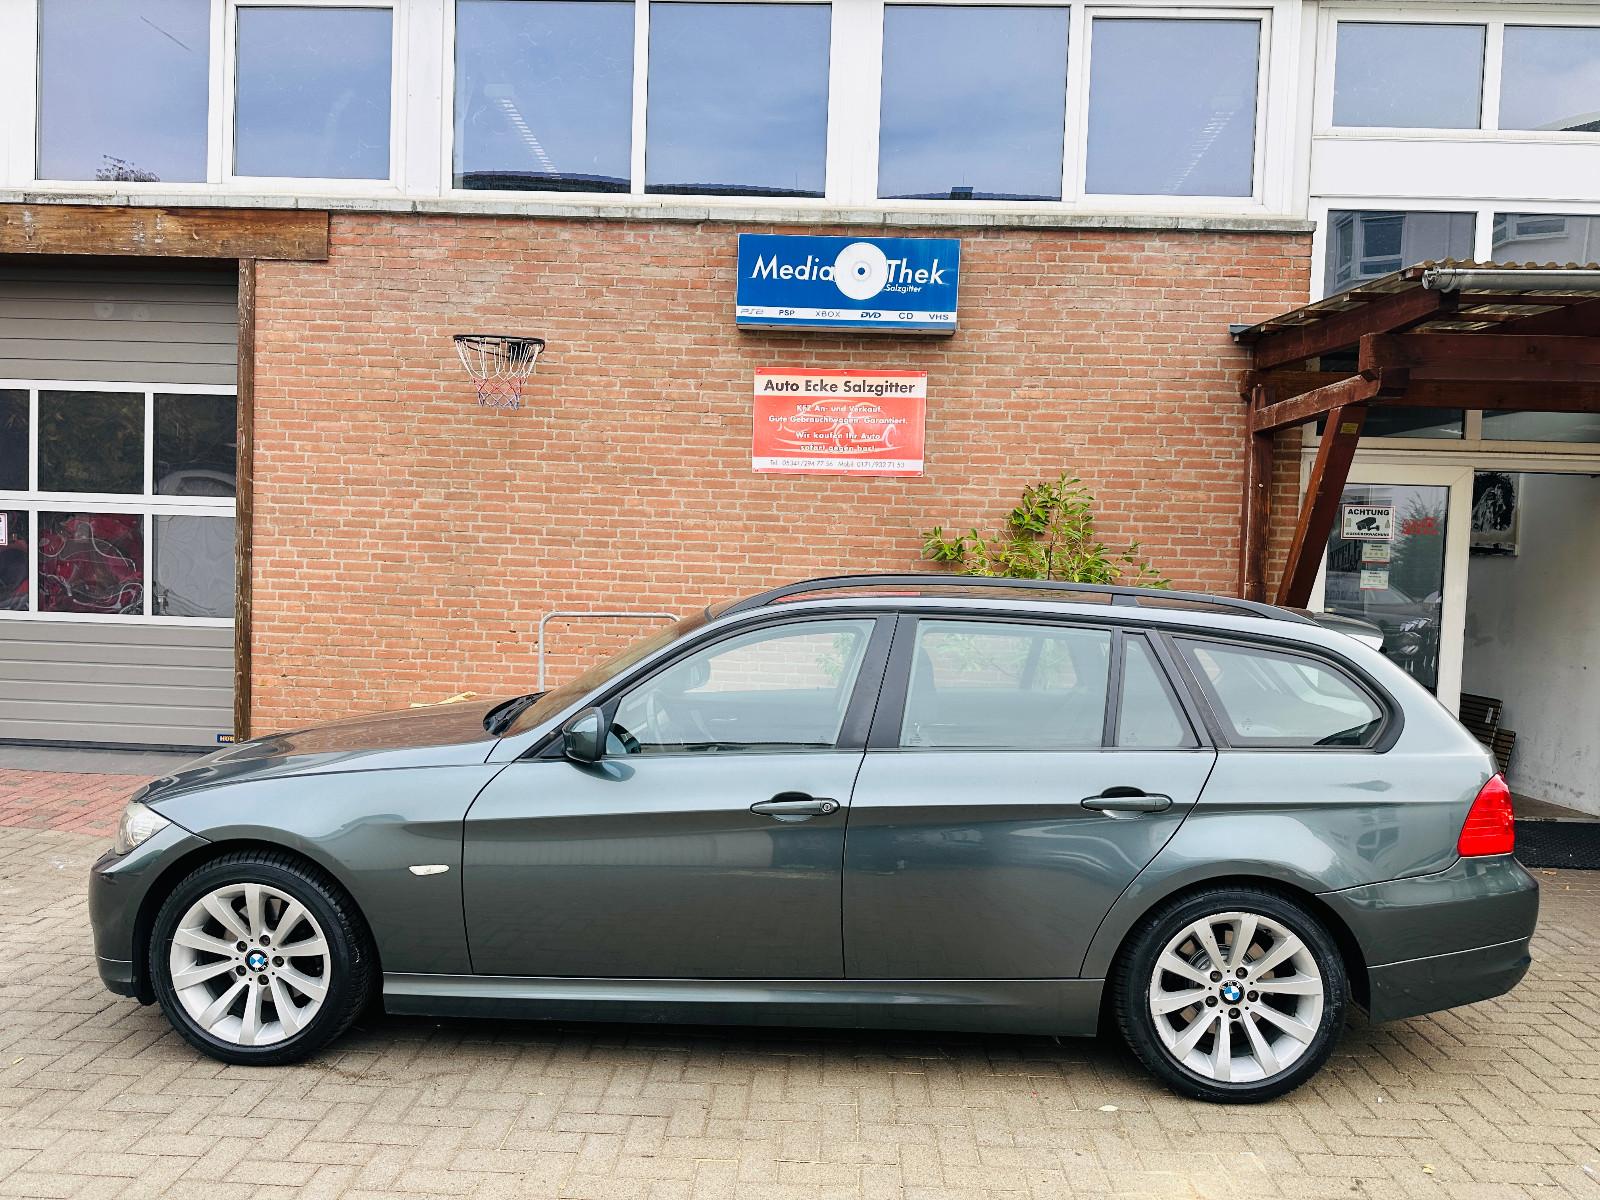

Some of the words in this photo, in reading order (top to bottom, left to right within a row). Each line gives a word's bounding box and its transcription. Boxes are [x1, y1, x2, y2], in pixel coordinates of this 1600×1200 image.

[751, 253, 836, 282] Media
[887, 257, 947, 285] Thek
[885, 283, 921, 294] Salzgitter
[860, 311, 881, 319] DVD
[898, 312, 914, 320] CD
[763, 379, 800, 393] Auto
[804, 379, 838, 393] Ecke
[843, 379, 915, 397] Salzgitter
[831, 404, 846, 412] und
[849, 405, 881, 413] Verkauf
[796, 431, 810, 439] Wir
[813, 431, 843, 440] kaufen
[846, 432, 858, 440] Ihr
[861, 432, 881, 440] Auto
[800, 443, 825, 451] sofort
[828, 445, 854, 453] gegen
[1347, 508, 1390, 516] ACHTUNG
